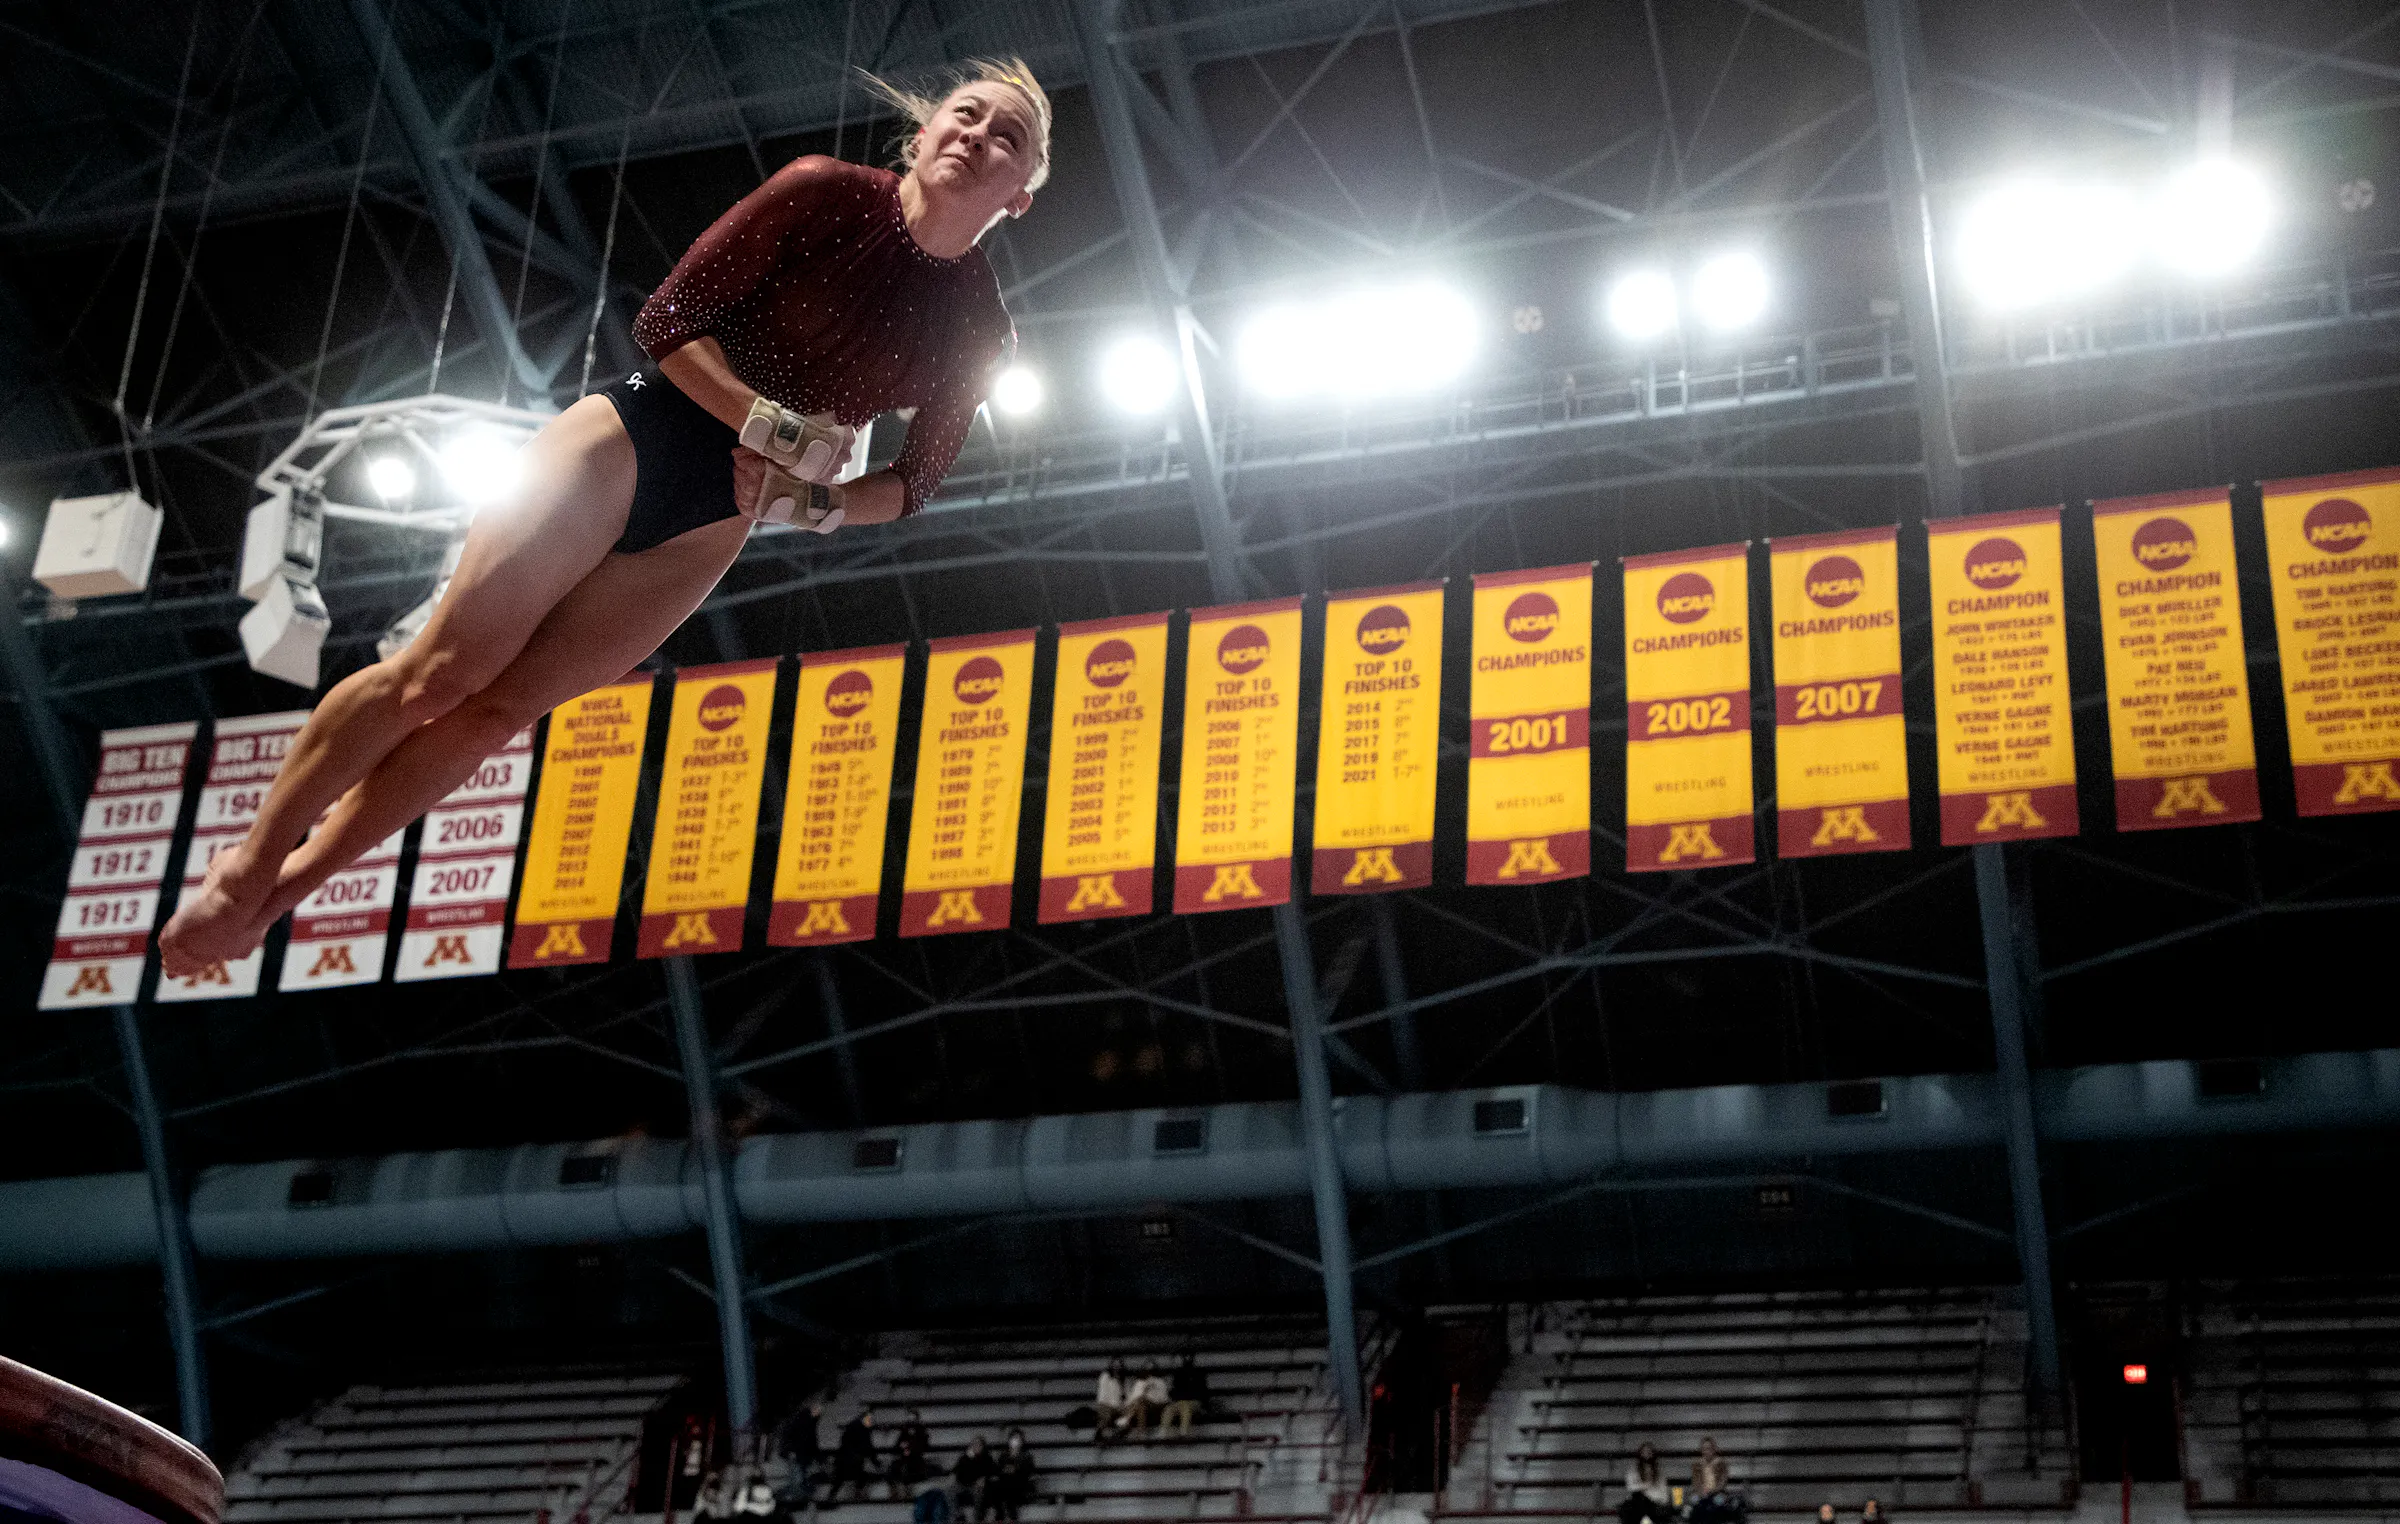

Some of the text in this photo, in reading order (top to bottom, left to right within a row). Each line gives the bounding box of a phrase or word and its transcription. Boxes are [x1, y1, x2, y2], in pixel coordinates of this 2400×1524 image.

[2311, 522, 2371, 541] NCAA
[2139, 540, 2197, 560] NCAA
[1970, 560, 2026, 579] NCAA
[2287, 553, 2398, 578] CHAMPION
[1811, 578, 1864, 596] NCAA
[2116, 572, 2222, 597] CHAMPION
[1662, 595, 1713, 613] NCAA
[1947, 591, 2049, 613] CHAMPION
[1509, 613, 1558, 632] NCAA
[1779, 611, 1894, 636] CHAMPIONS
[2293, 615, 2342, 631] BROCK
[1361, 626, 1409, 644] NCAA
[1632, 627, 1743, 653] CHAMPIONS
[2119, 626, 2228, 648] EVAN JOHNSON
[1222, 645, 1267, 664] NCAA
[1478, 646, 1585, 672] CHAMPIONS
[1952, 651, 1985, 664] DALE
[1090, 659, 1134, 678] NCAA
[1354, 658, 1411, 676] TOP 10
[958, 677, 1002, 693] NCAA
[1215, 676, 1271, 695] TOP 10
[1344, 674, 1420, 694] FINISHES
[1951, 674, 2053, 695] LEONARD LEVY
[1082, 689, 1137, 708] TOP 10
[1205, 692, 1278, 714] FINISHES
[1346, 701, 1381, 714] 2014
[1795, 681, 1882, 717] 2007
[2120, 686, 2237, 708] MARTY MORGAN
[564, 712, 633, 729] NATIONAL
[950, 707, 1003, 724] TOP 10
[1072, 704, 1143, 727] FINISHES
[1345, 717, 1380, 731] 2015
[1647, 697, 1730, 733] 2002
[1956, 704, 2052, 723] VERNE GAGNE
[820, 720, 872, 737] TOP 10
[939, 723, 1009, 742] FINISHES
[1490, 716, 1566, 751] 2001
[217, 737, 257, 762] BIG
[550, 742, 635, 761] CHAMPIONS
[693, 734, 744, 749] TOP 10
[810, 735, 878, 755] FINISHES
[1344, 734, 1378, 747] 2017
[1954, 734, 2051, 754] VERNE GAGNE
[102, 744, 189, 774] BIG TEN
[682, 749, 749, 768] FINISHES
[464, 763, 513, 790] 003
[1342, 769, 1375, 782] 2021
[218, 791, 259, 816] 194
[2153, 778, 2227, 816] M
[102, 800, 164, 828] 1910
[1976, 794, 2045, 830] M
[438, 814, 506, 844] 2006
[1812, 808, 1878, 846] M
[1659, 824, 1722, 860] M
[91, 849, 152, 877] 1912
[1342, 848, 1402, 884] M
[1498, 839, 1560, 876] M
[429, 866, 497, 896] 2007
[1203, 865, 1261, 901] M
[315, 877, 379, 908] 2002
[1067, 875, 1123, 911] M
[79, 900, 140, 928] 1913
[796, 901, 849, 934] M
[927, 890, 982, 925] M
[535, 925, 585, 957] M
[663, 914, 715, 947] M
[306, 945, 357, 978] M
[423, 935, 473, 968] M
[66, 963, 114, 997] M
